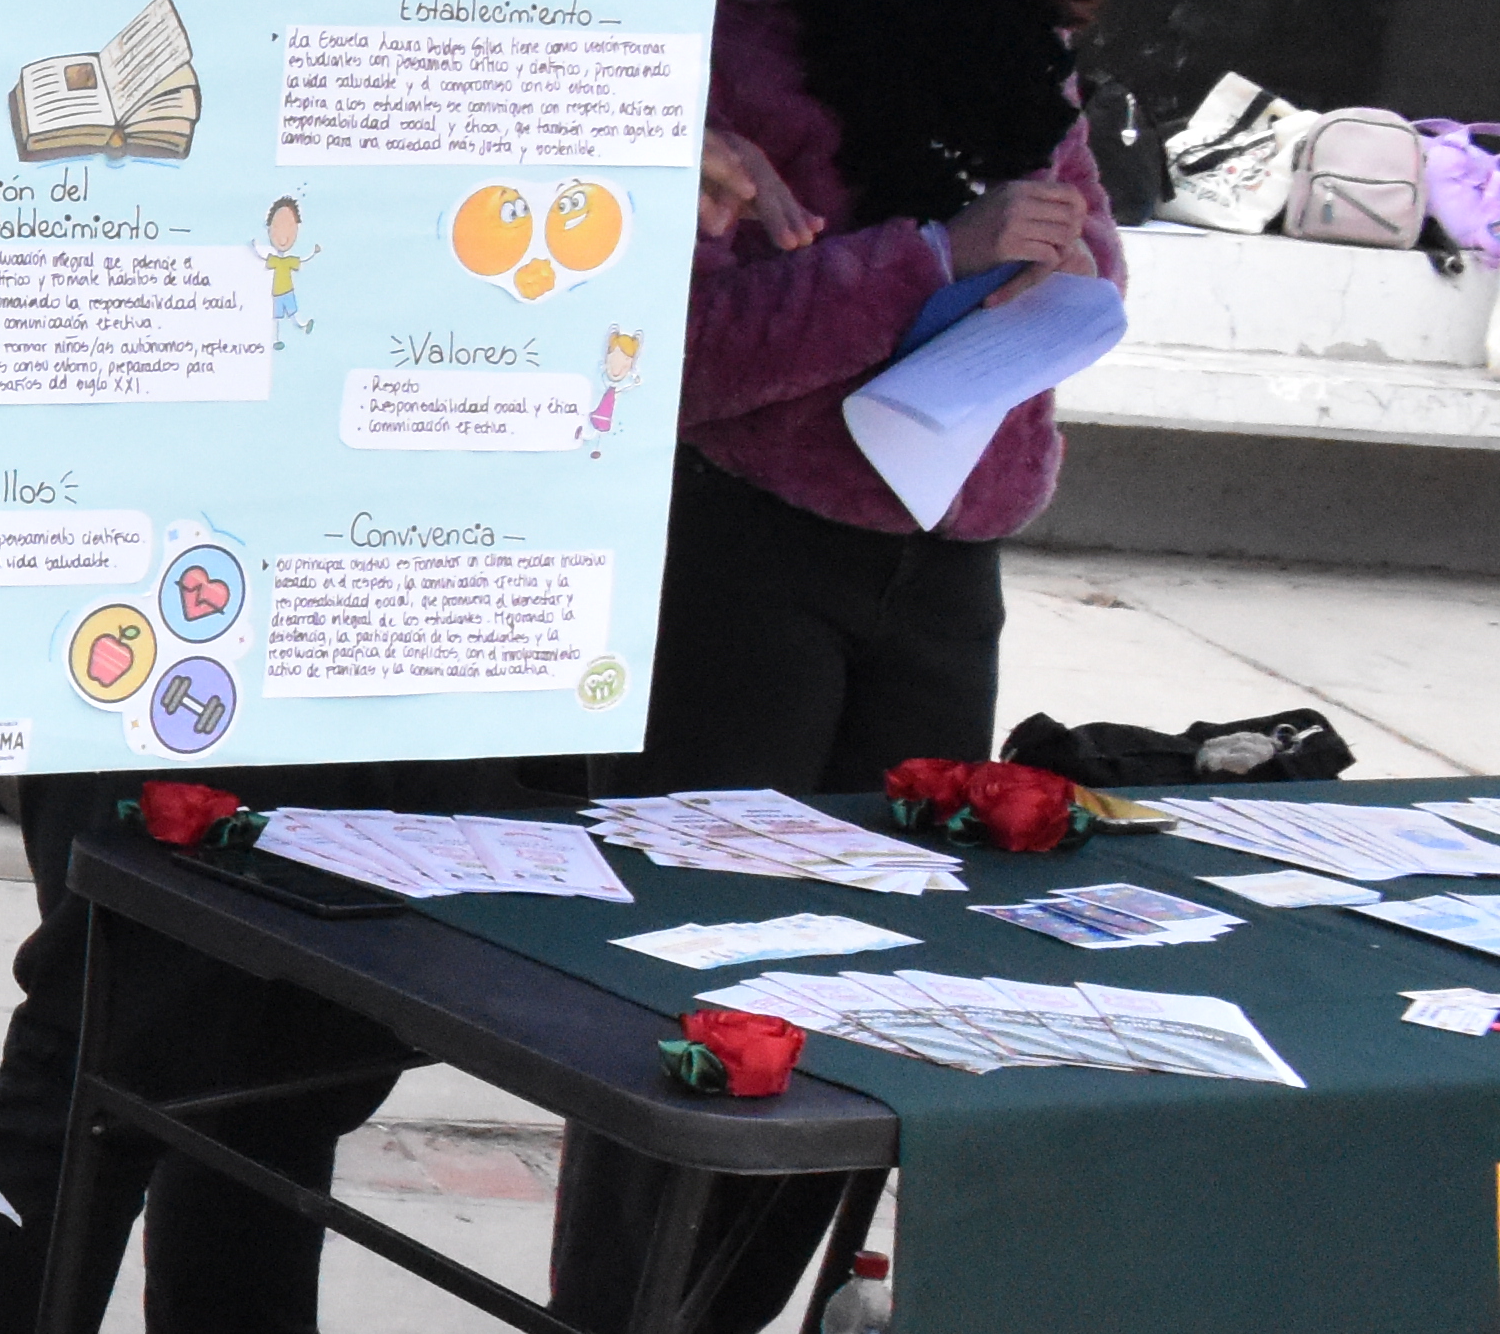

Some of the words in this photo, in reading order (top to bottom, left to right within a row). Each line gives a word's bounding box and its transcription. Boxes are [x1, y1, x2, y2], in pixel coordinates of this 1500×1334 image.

[50, 166, 89, 201] del
[38, 275, 45, 292] y
[164, 273, 177, 286] de
[66, 295, 80, 309] la
[408, 331, 518, 366] Valores
[186, 362, 215, 378] para
[533, 403, 541, 418] y
[349, 511, 496, 548] Convivencia
[6, 555, 38, 569] vida
